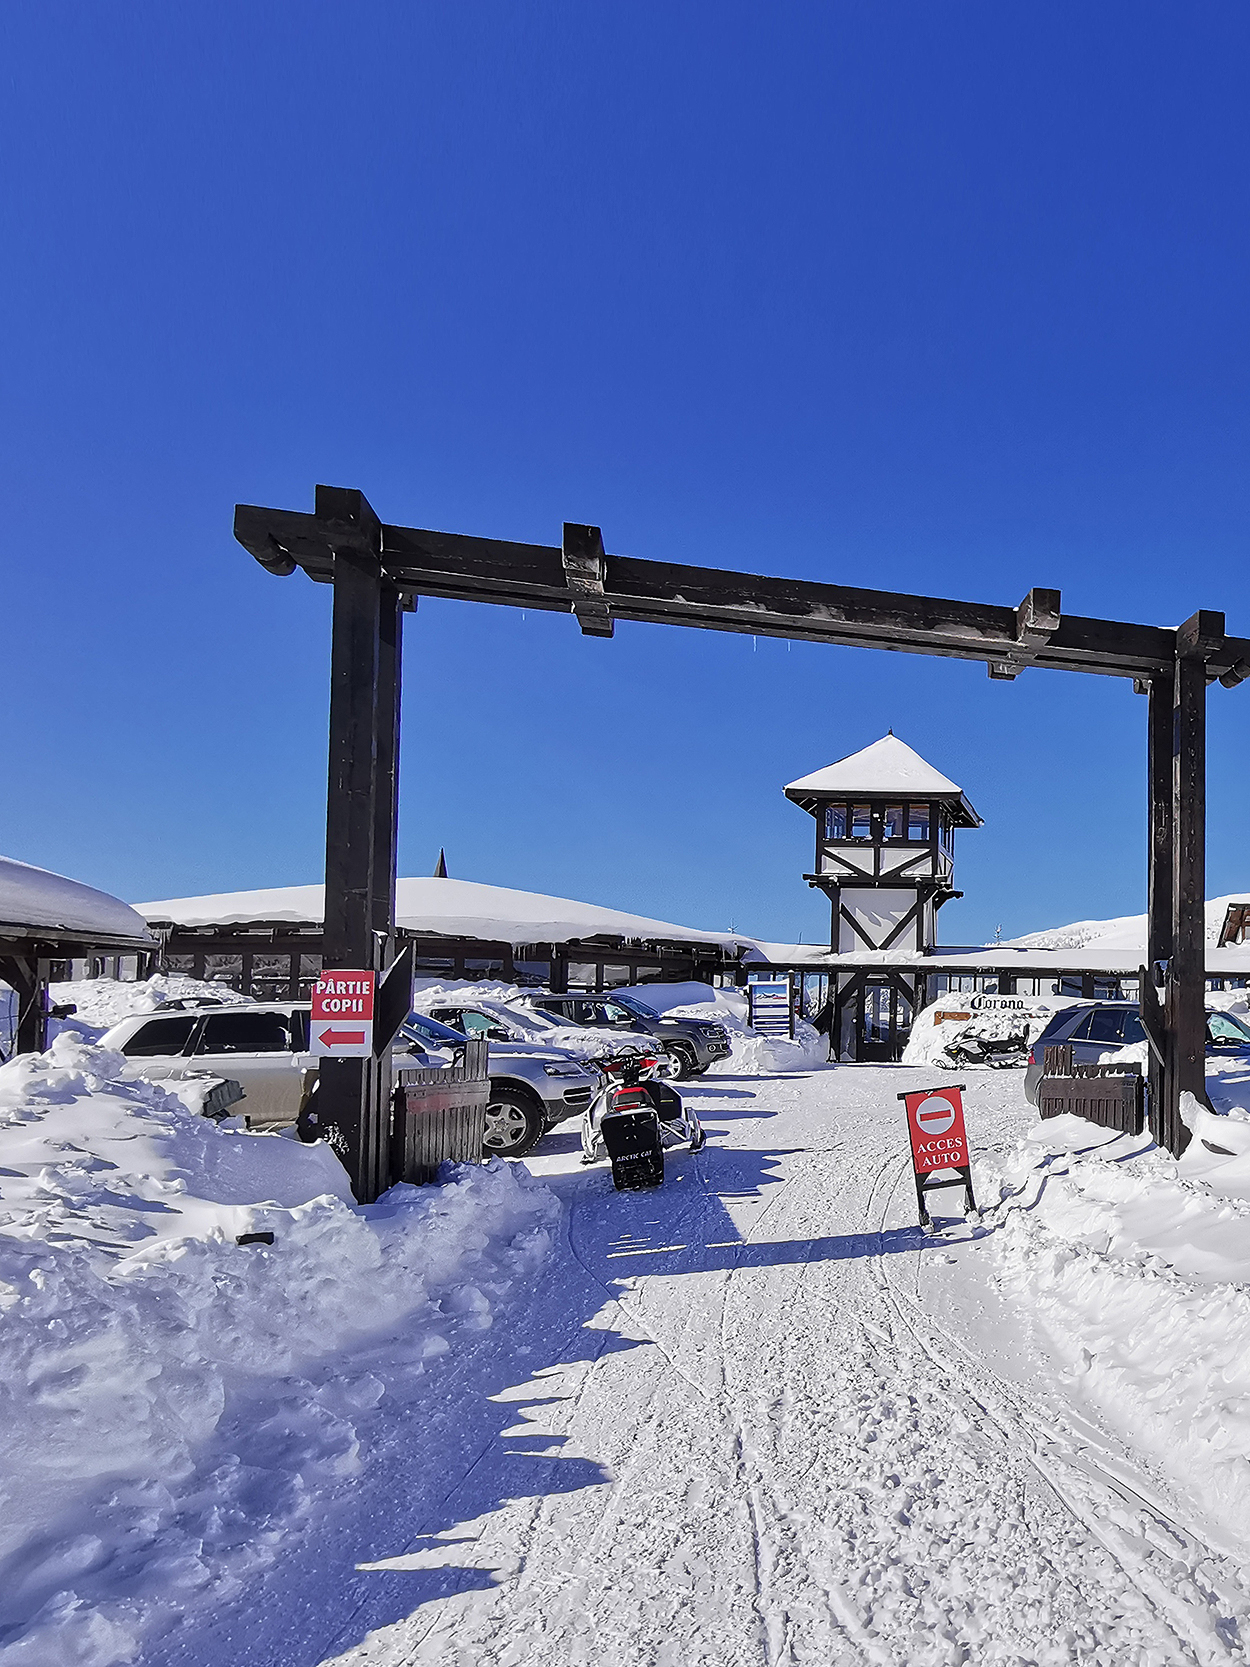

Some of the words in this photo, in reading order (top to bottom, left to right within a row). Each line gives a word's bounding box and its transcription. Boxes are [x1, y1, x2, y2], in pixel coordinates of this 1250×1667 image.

[315, 978, 370, 995] PÂRTIE
[321, 998, 363, 1013] COPII
[970, 994, 1025, 1011] Corona
[917, 1137, 963, 1154] ACCES
[615, 1152, 640, 1163] ARCTIC
[640, 1149, 653, 1158] CAT
[922, 1151, 961, 1167] AUTO
